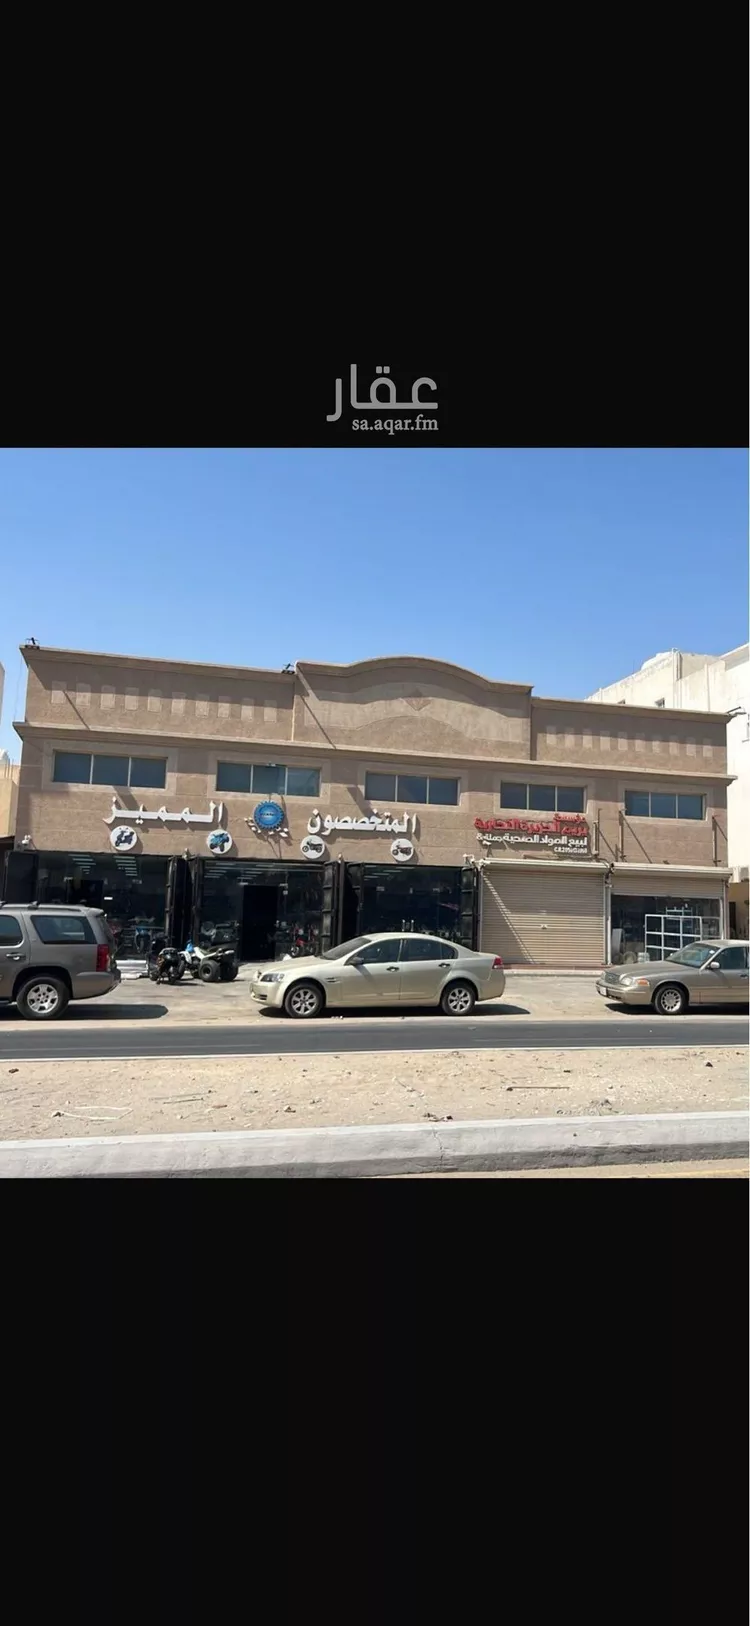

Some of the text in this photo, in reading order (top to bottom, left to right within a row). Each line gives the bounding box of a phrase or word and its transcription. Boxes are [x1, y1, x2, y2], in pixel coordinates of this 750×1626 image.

[103, 796, 223, 824] المميز
[307, 808, 417, 835] المتخصصون
[503, 833, 540, 843] الصحية
[540, 835, 568, 846] المواد
[567, 837, 588, 847] لبيع
